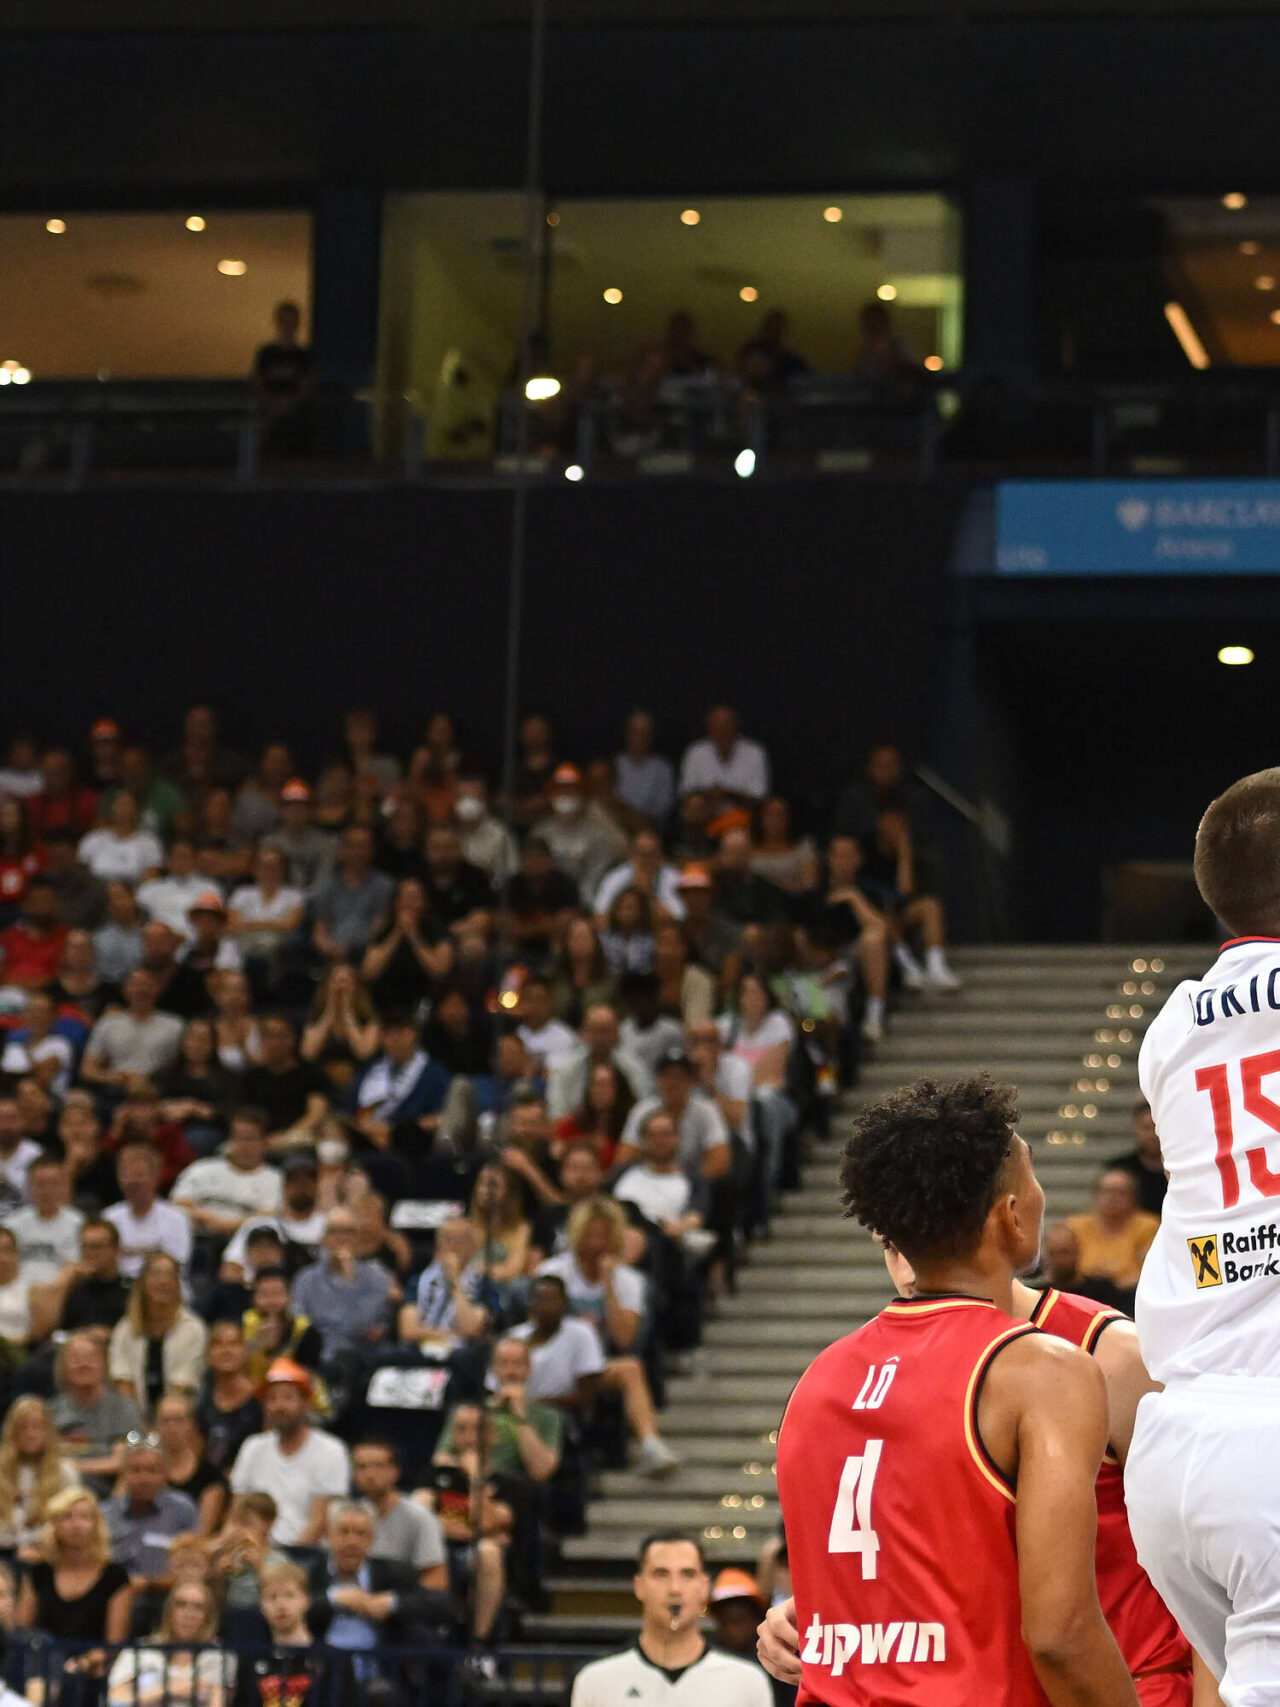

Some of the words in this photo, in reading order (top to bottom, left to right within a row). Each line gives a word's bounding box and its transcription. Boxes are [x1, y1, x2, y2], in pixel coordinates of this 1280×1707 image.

[1224, 1253, 1280, 1283] Bank
[851, 1356, 900, 1410] LÔ
[828, 1439, 884, 1580] 4
[801, 1613, 946, 1677] tipwin
